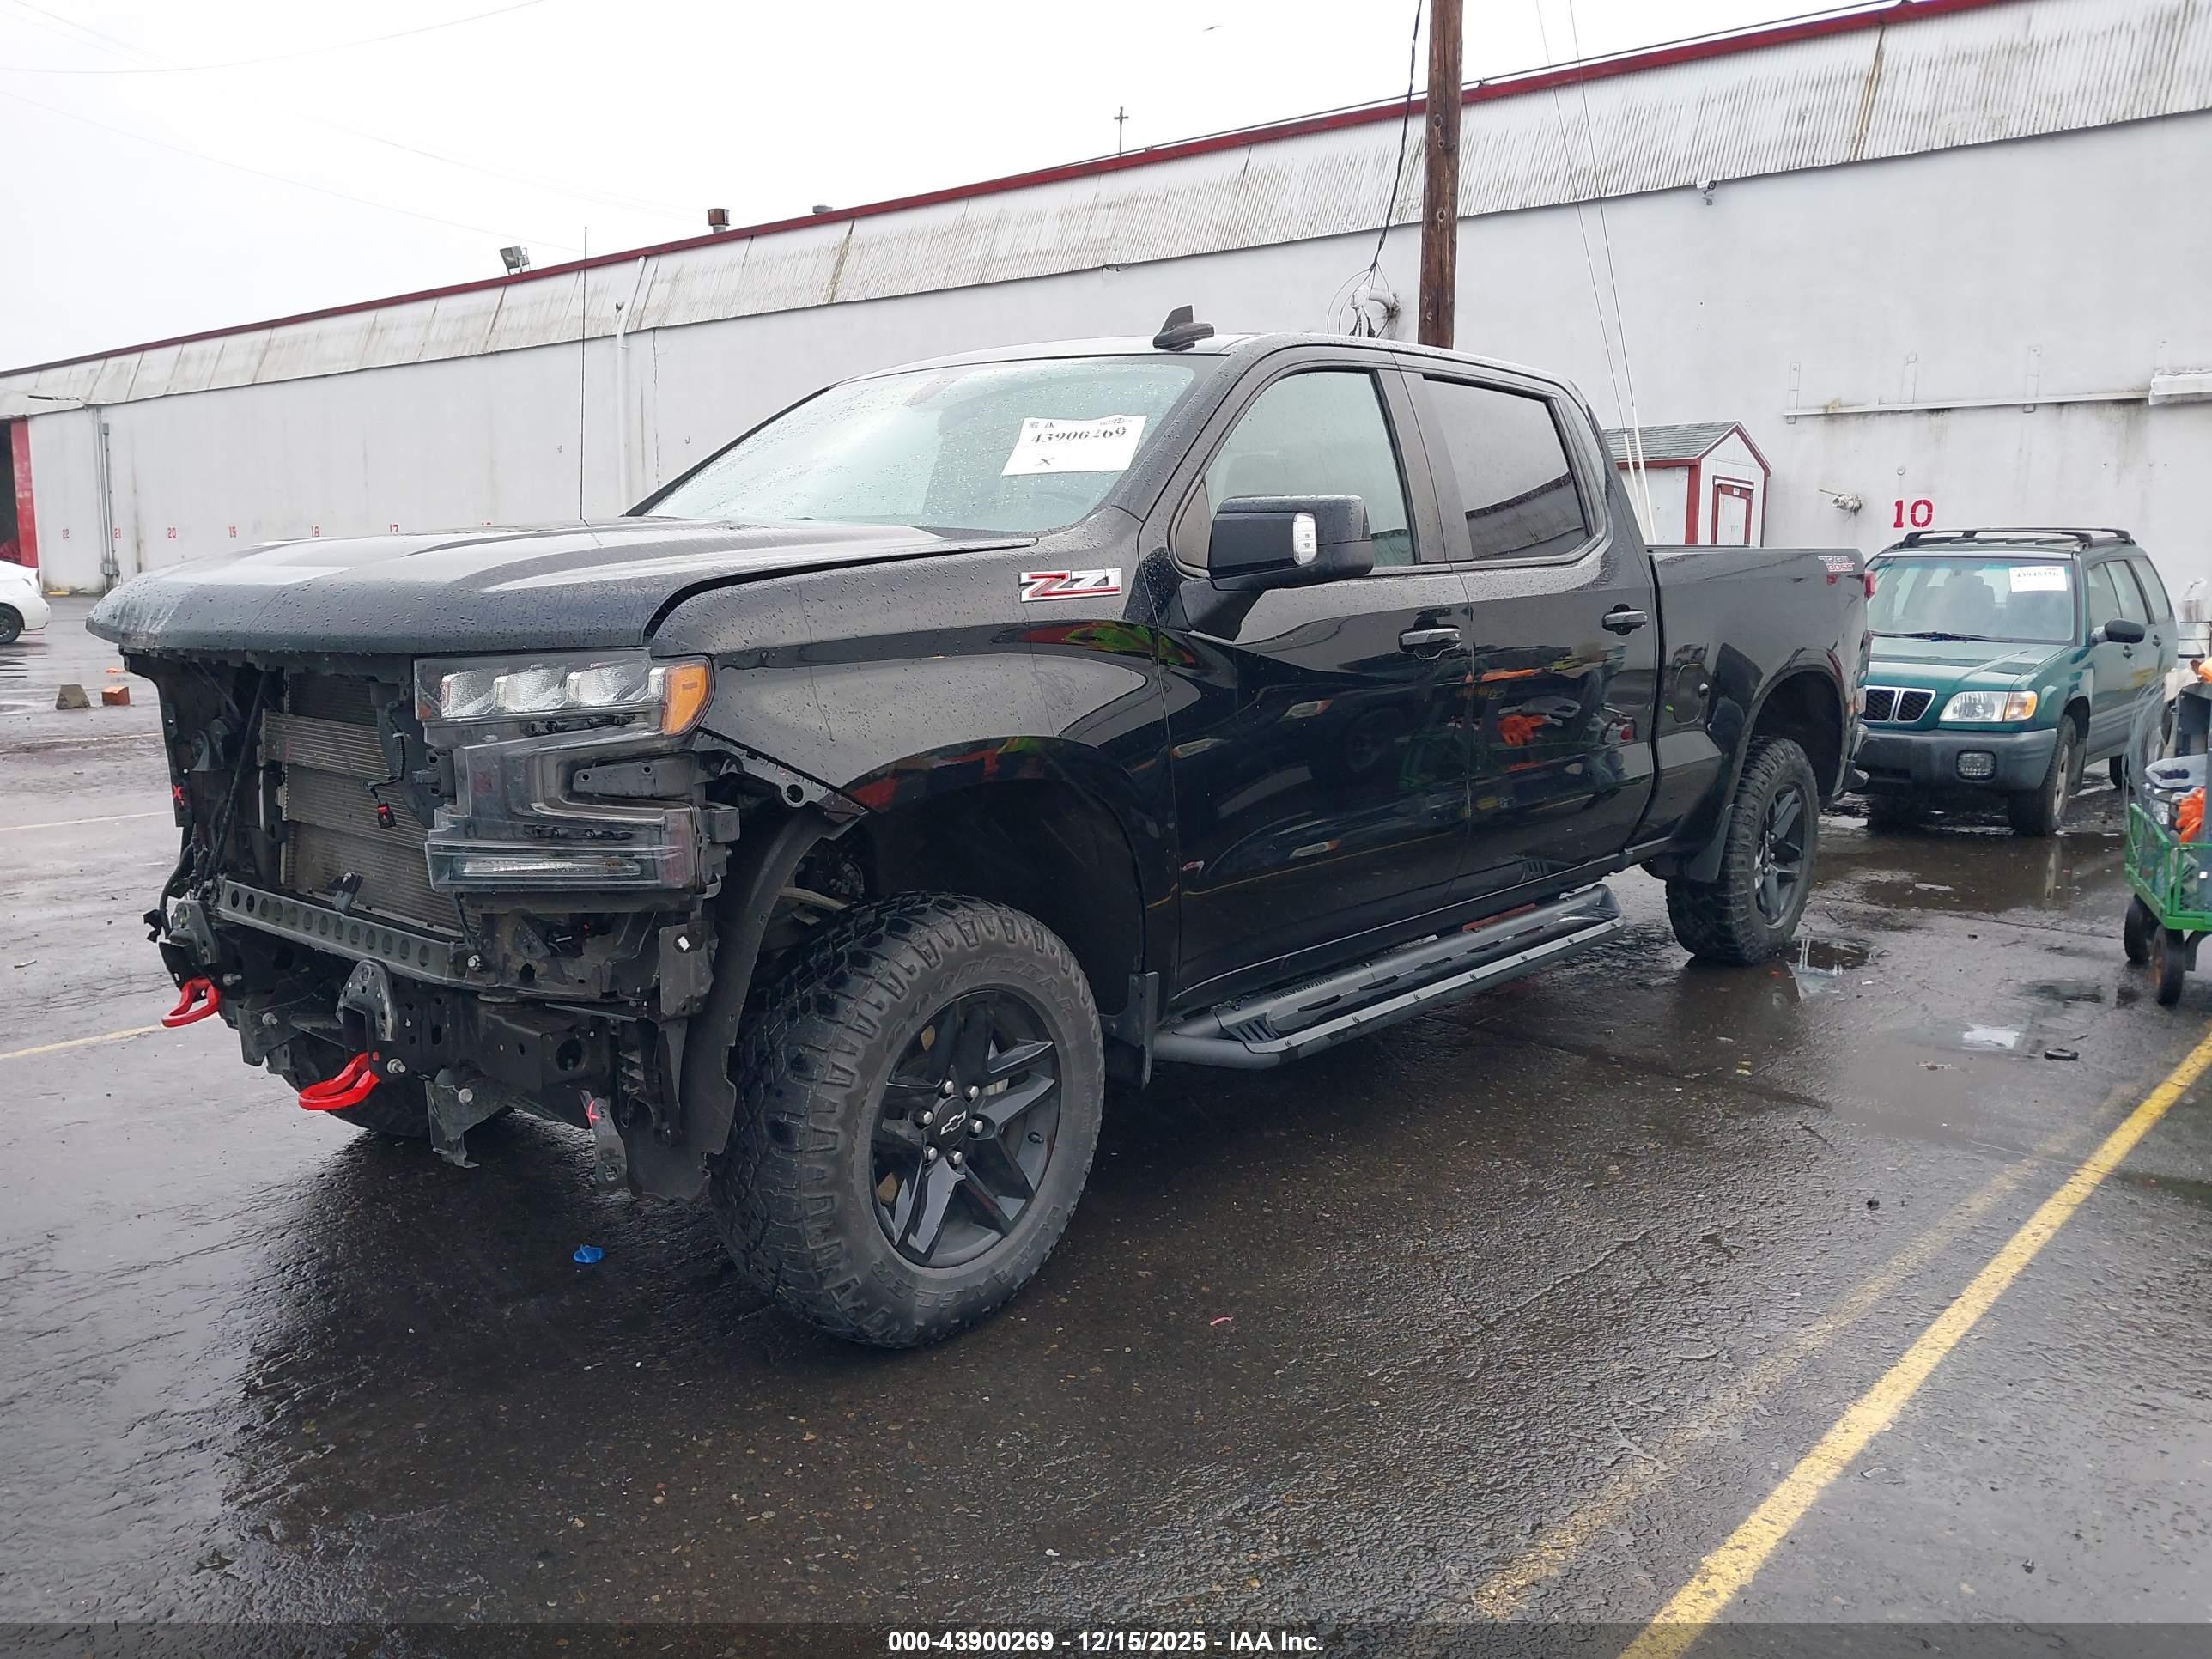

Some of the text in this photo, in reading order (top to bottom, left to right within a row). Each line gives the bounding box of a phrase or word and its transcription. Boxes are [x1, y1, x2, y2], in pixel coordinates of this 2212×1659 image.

[1893, 499, 1933, 528] 10
[167, 526, 177, 539] 20
[1817, 556, 1855, 565] TRAIL
[1827, 563, 1855, 572] BOSS
[1019, 568, 1122, 603] Z71
